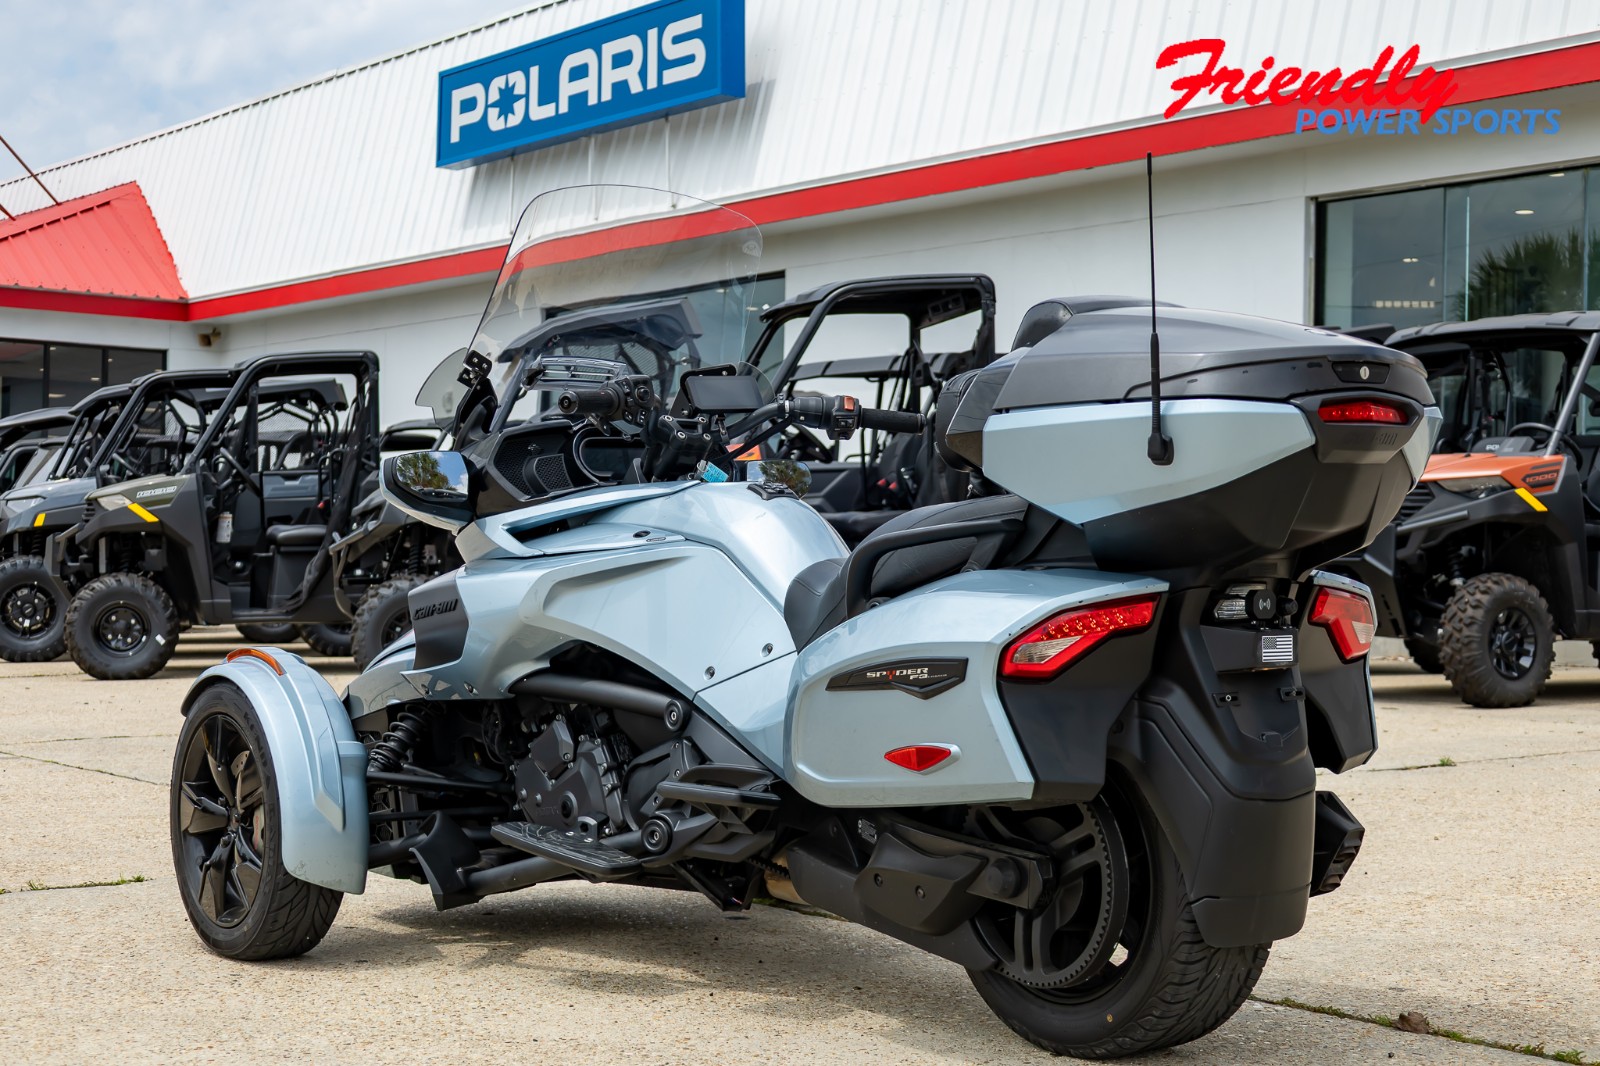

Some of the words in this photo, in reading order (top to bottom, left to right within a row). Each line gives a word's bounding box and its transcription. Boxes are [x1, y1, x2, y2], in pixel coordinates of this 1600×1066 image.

[450, 13, 706, 144] POLARIS
[1525, 472, 1558, 484] 1000
[866, 667, 929, 680] SPYDER
